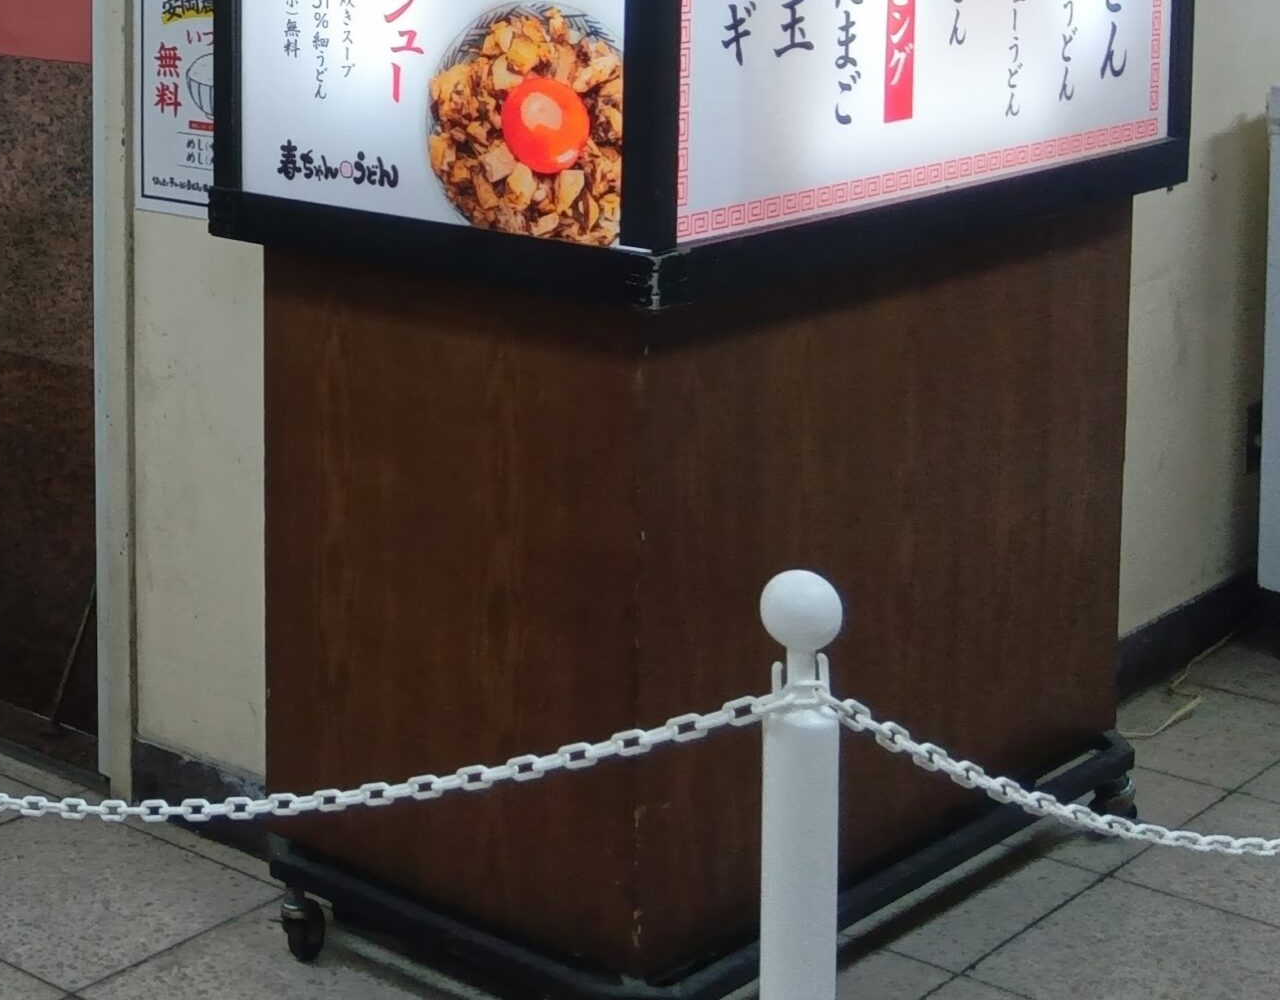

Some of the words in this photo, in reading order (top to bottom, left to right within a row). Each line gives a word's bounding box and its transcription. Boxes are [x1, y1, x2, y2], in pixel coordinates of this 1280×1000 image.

[154, 41, 182, 118] 無料
[277, 139, 340, 182] 春ちゃん
[353, 151, 400, 188] うどん
